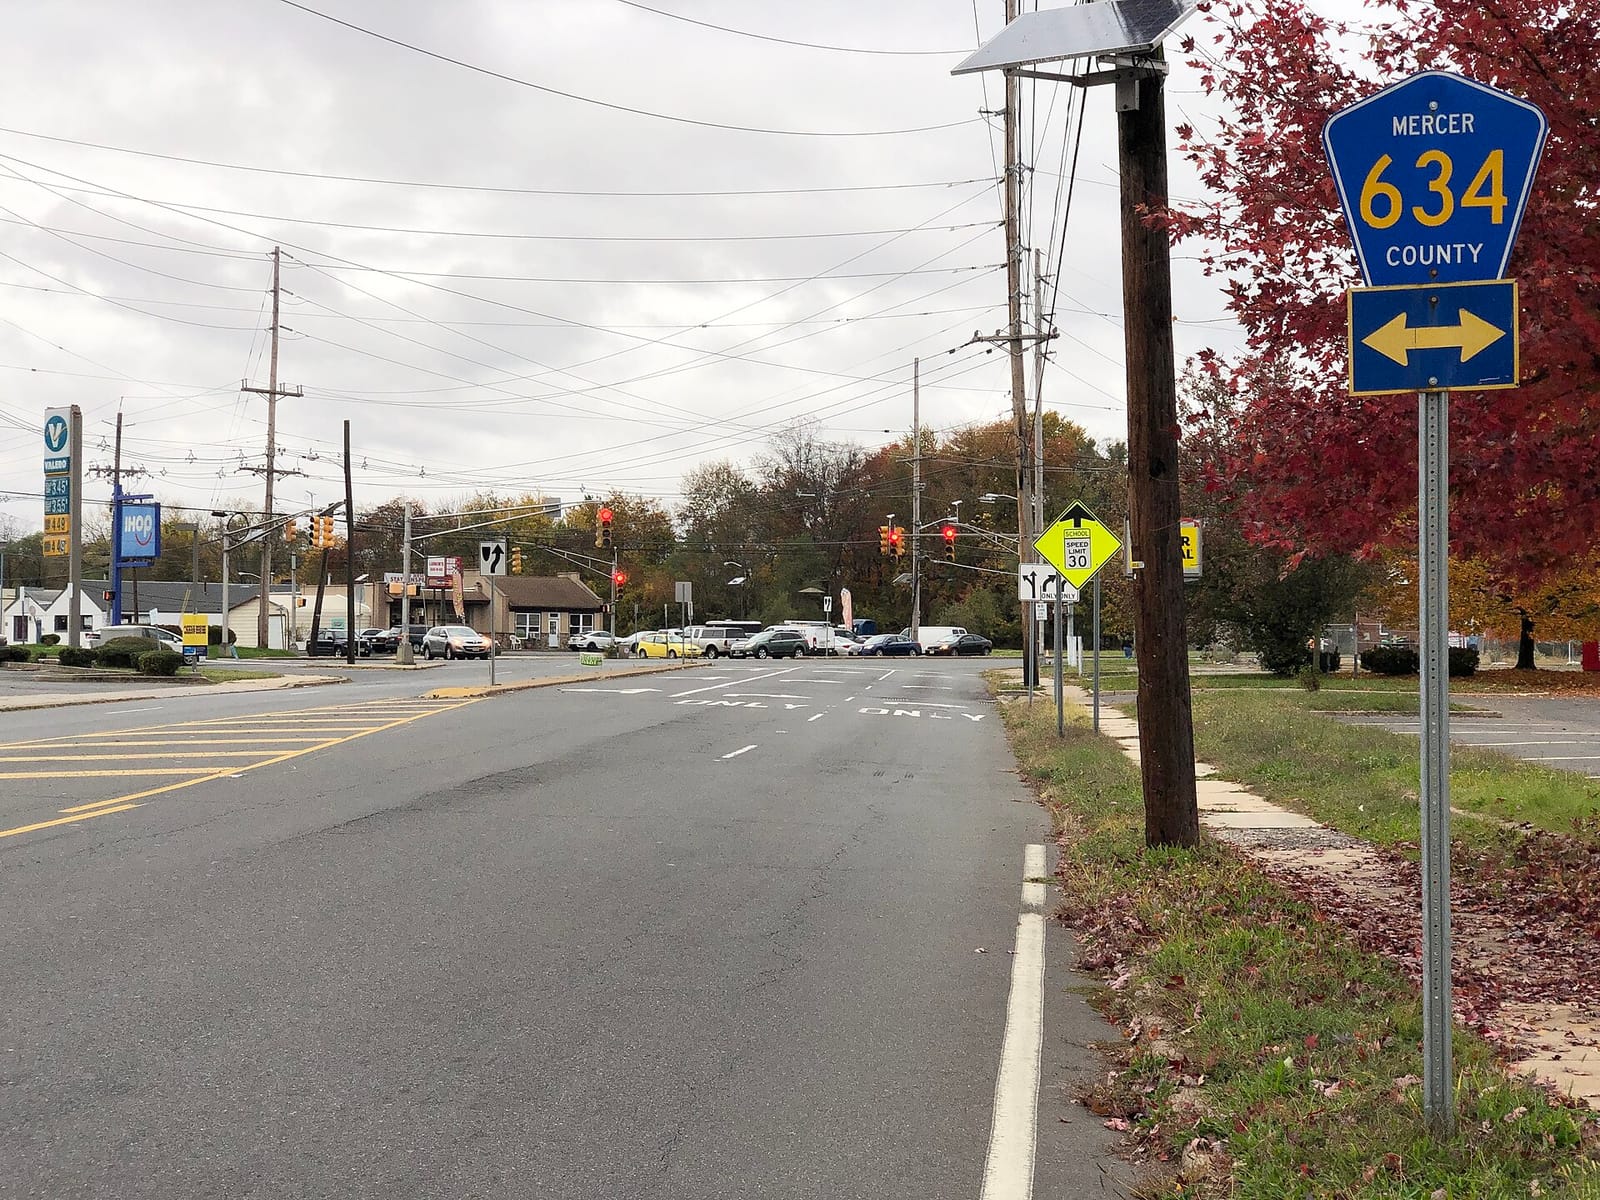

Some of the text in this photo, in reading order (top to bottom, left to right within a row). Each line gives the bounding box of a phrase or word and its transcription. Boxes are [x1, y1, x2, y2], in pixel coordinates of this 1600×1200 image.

[1392, 113, 1475, 136] MERCER
[1359, 149, 1508, 229] 634
[1386, 243, 1484, 267] COUNTY
[44, 459, 68, 470] VALERO
[1068, 555, 1087, 568] 30
[858, 706, 986, 722] ONLY
